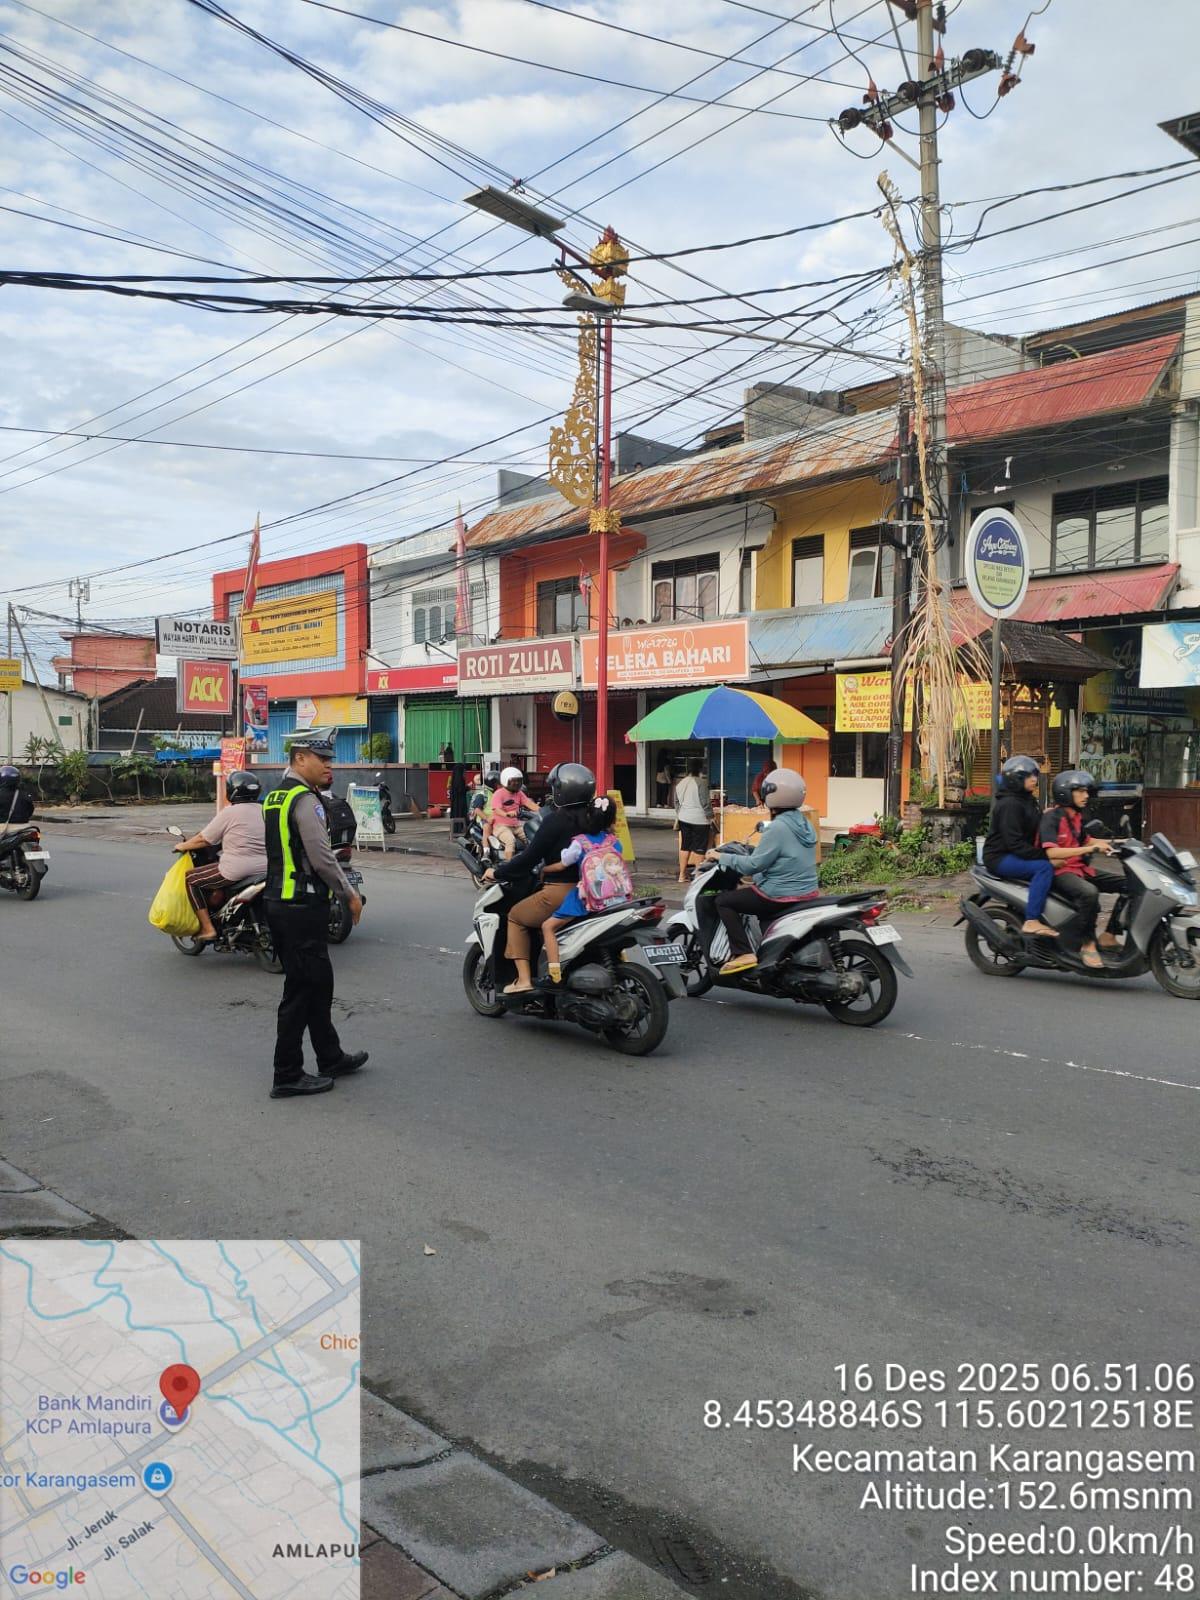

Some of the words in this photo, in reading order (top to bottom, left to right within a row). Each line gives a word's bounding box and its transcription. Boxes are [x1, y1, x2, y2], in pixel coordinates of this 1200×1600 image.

[163, 633, 181, 642] WAYAN
[182, 635, 198, 644] HARRY
[174, 621, 231, 636] NOTARIS
[466, 654, 503, 677] ROTI
[509, 648, 563, 674] ZULIA
[663, 646, 731, 666] BAHARI
[189, 676, 224, 702] ACK
